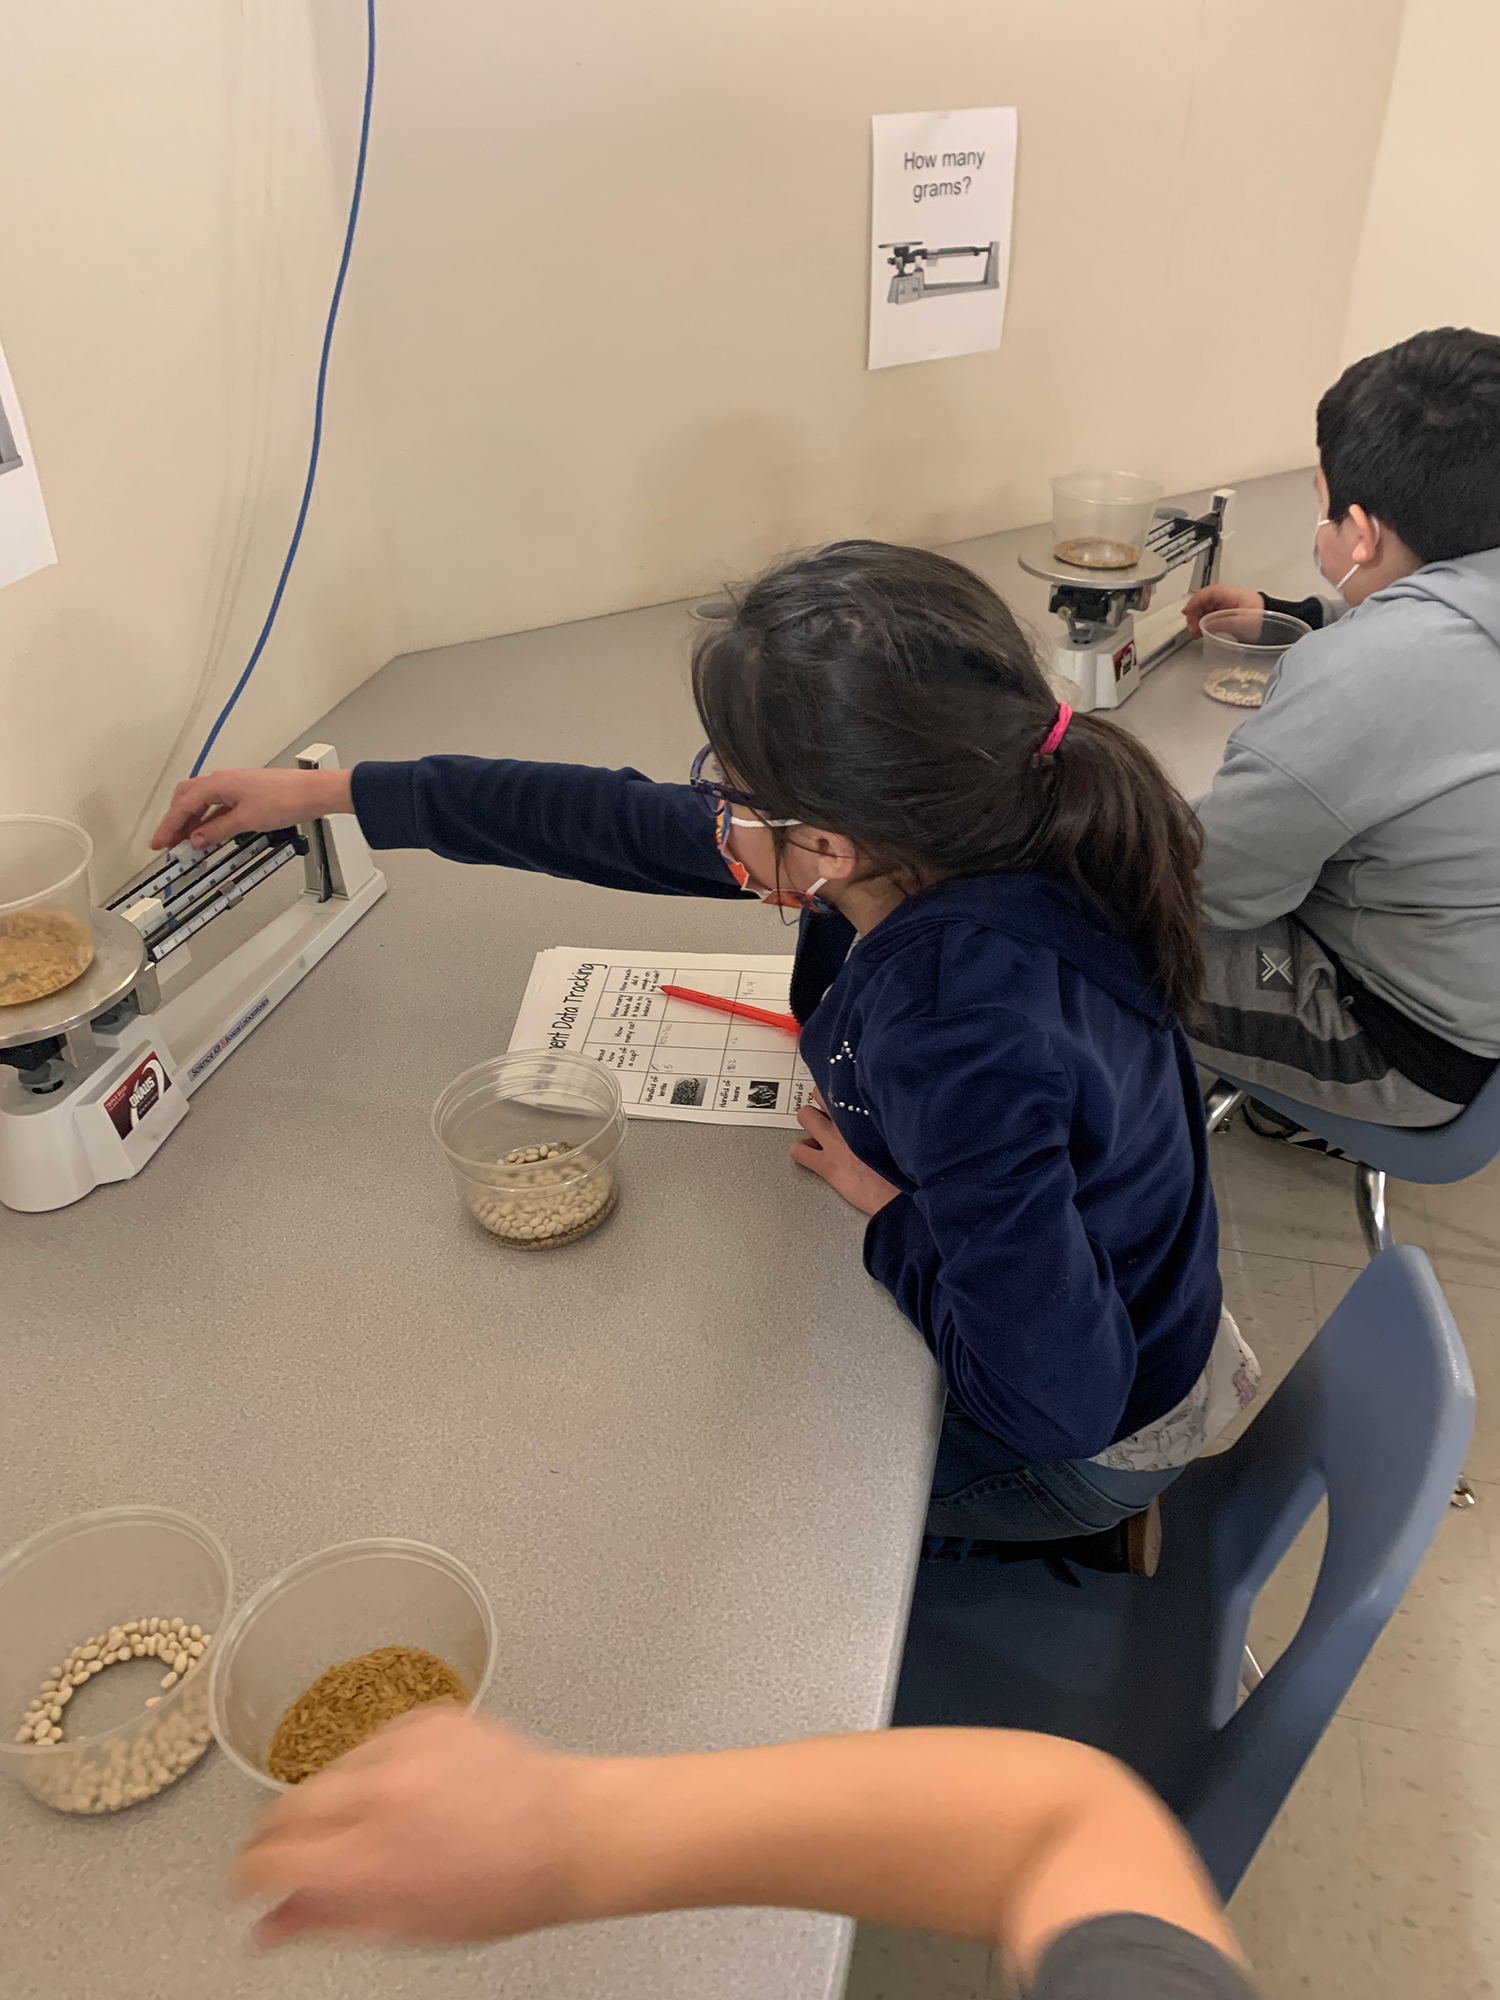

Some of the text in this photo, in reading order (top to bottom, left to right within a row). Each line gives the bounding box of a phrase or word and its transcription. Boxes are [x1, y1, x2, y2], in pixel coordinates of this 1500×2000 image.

[904, 151, 985, 170] How many
[913, 175, 972, 203] grams?
[563, 963, 608, 1003] Tracking
[619, 969, 632, 991] How much
[551, 1007, 579, 1029] Data
[611, 1007, 619, 1017] How
[614, 1026, 623, 1037] How
[625, 1031, 635, 1043] many
[191, 1053, 214, 1076] Science
[220, 1038, 227, 1049] &
[606, 1052, 615, 1062] how
[617, 1055, 625, 1068] much
[630, 1050, 639, 1062] cup?
[129, 1076, 156, 1108] OHAUS
[645, 1082, 657, 1102] Handful
[719, 1086, 730, 1107] Handful
[730, 1086, 741, 1101] beans
